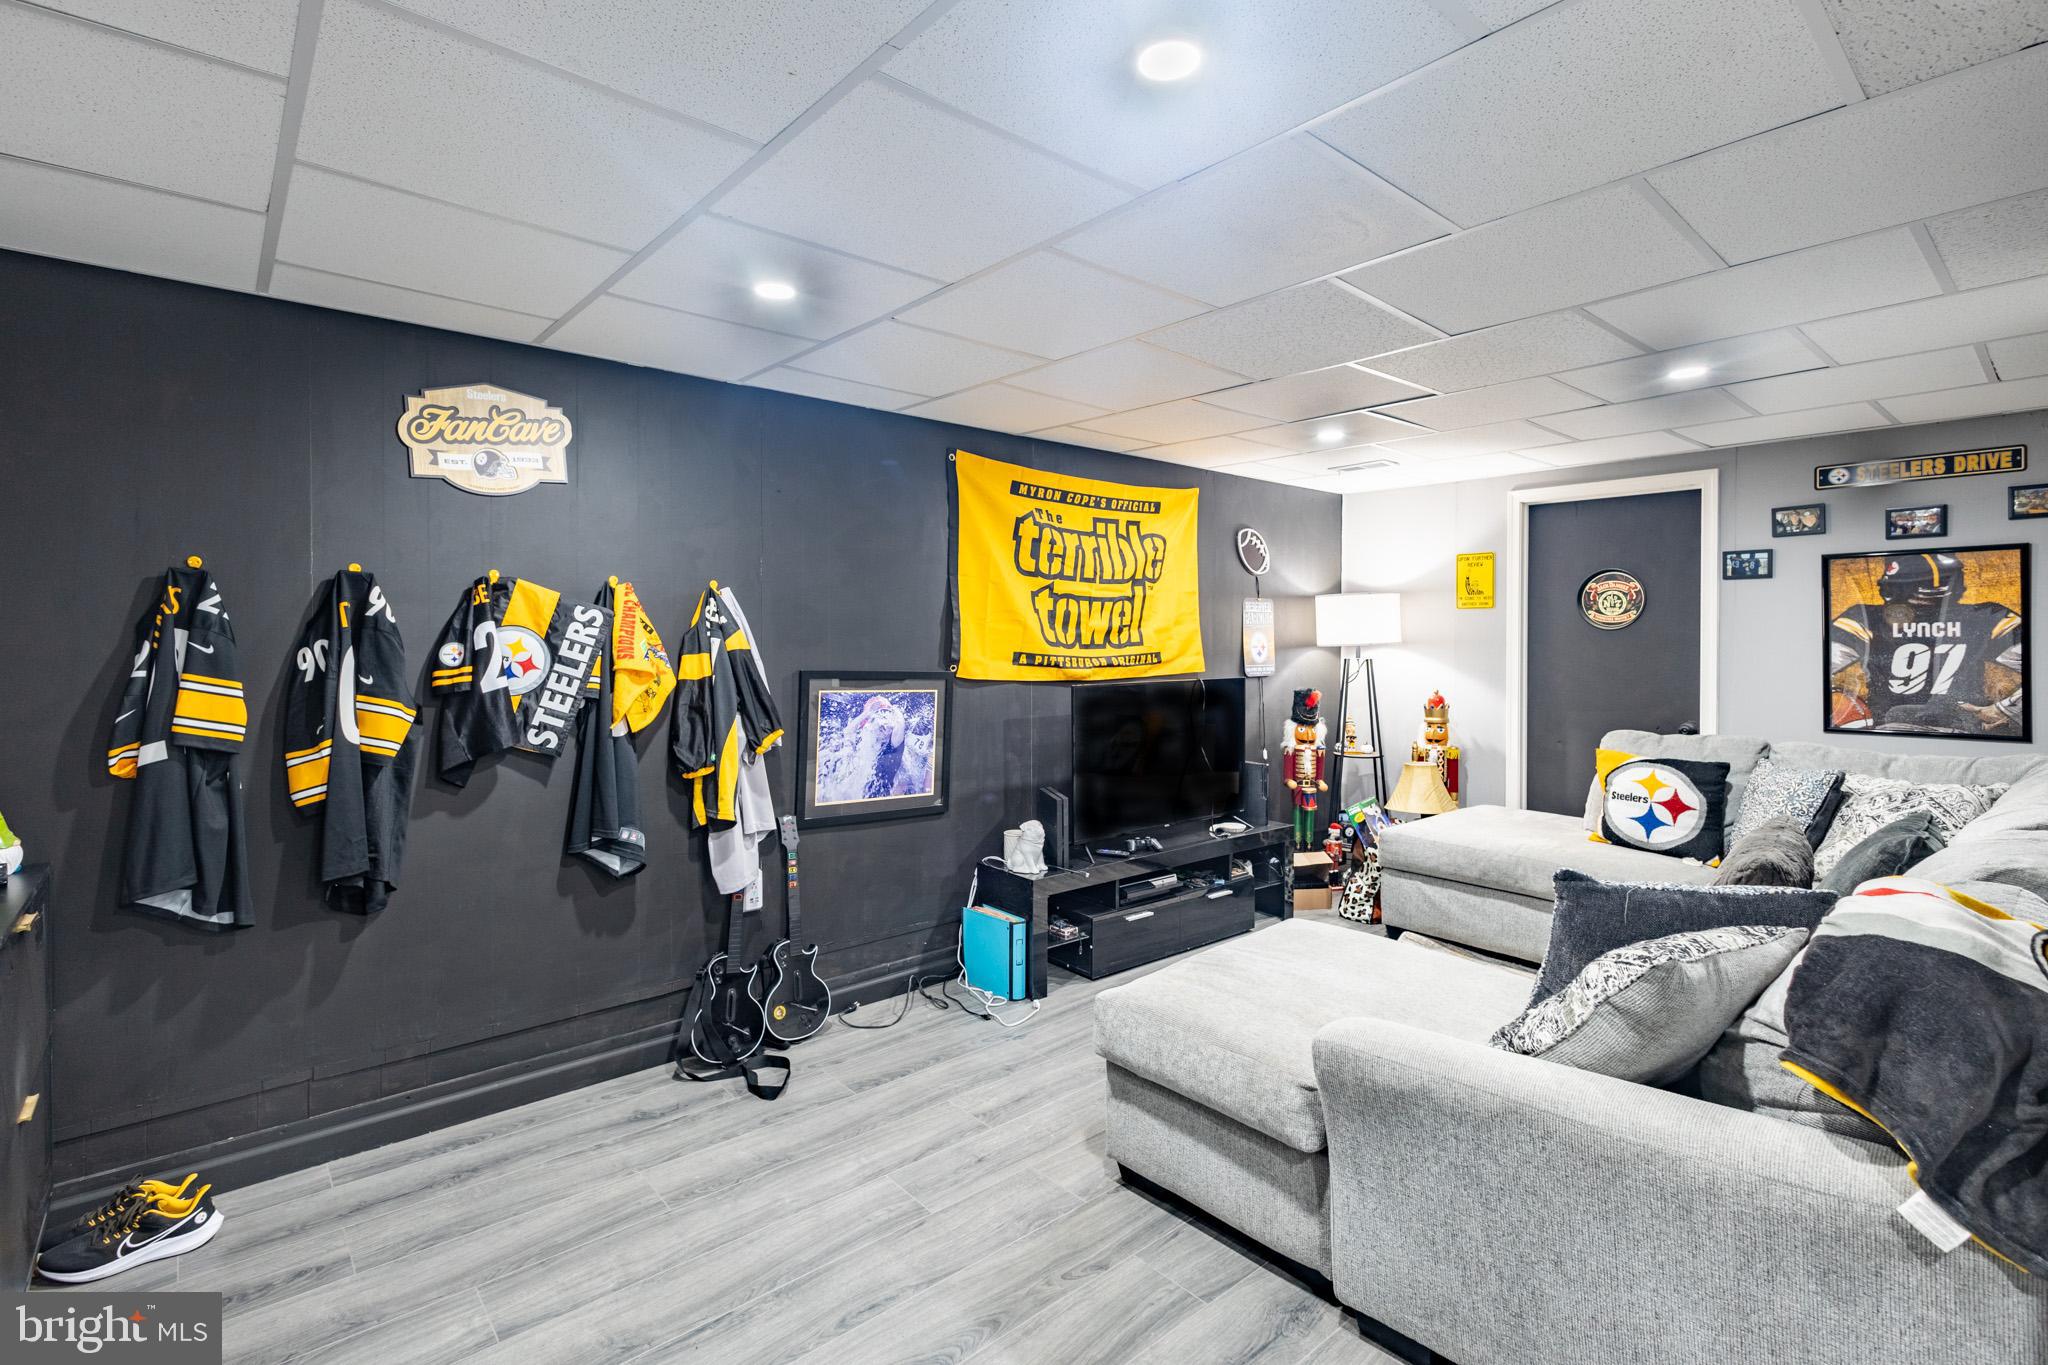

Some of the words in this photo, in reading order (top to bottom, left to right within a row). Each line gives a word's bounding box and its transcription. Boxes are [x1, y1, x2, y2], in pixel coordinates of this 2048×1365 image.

[1855, 457, 1946, 481] STEELERS
[1954, 451, 2013, 473] DRIVE
[1018, 484, 1062, 502] MYRON
[1066, 492, 1106, 509] COPE'S
[1111, 498, 1156, 513] OFFICIAL
[1035, 508, 1062, 524] The
[1013, 512, 1167, 584] terrible
[1031, 580, 1146, 649] towel
[1892, 621, 1961, 638] LYNCH
[616, 600, 637, 660] CHAMPIONS
[1019, 654, 1027, 664] A
[1036, 656, 1107, 668] PITTSBURGH
[1112, 653, 1158, 667] ORIGINAL
[1888, 642, 1967, 695] 97
[526, 605, 604, 748] STEELERS
[1611, 791, 1649, 804] Steelers
